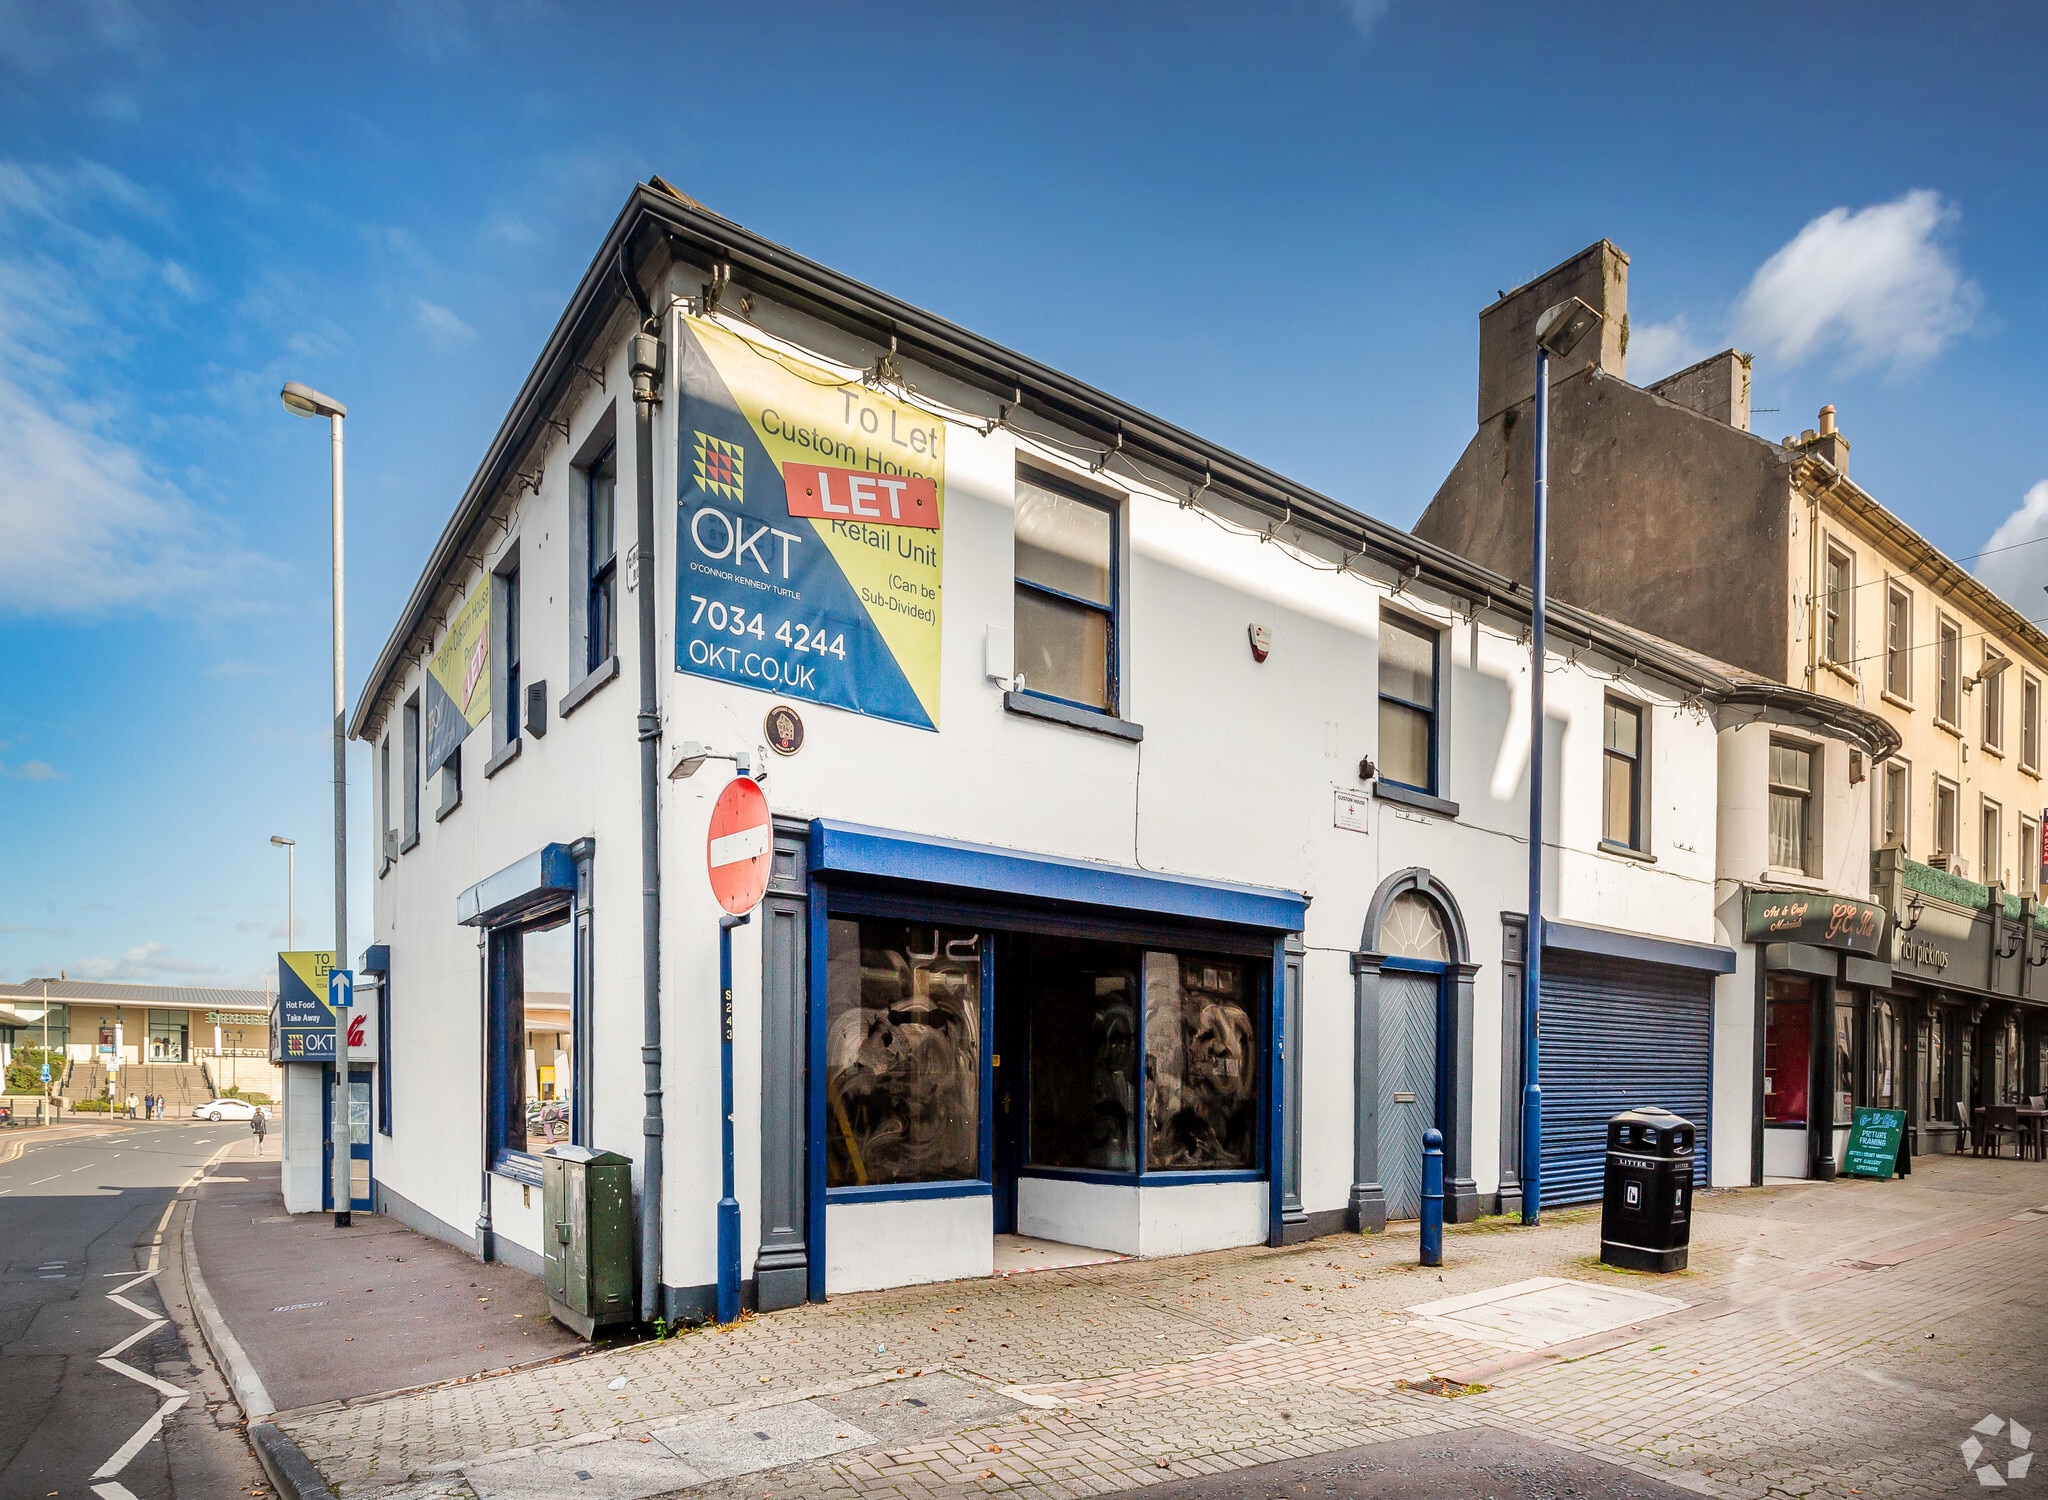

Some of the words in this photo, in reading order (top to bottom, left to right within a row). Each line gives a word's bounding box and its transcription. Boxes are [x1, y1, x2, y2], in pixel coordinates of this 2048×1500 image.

[761, 408, 856, 465] Custom
[837, 387, 879, 434] To
[891, 409, 938, 460] Let
[818, 471, 907, 519] LET
[691, 507, 802, 579] OKT
[832, 519, 890, 552] Retail
[898, 535, 937, 568] Unit
[690, 562, 734, 582] O'CONNOR
[734, 575, 772, 592] KENNEDY
[772, 585, 801, 600] TURTLE
[889, 573, 917, 595] (Can
[921, 584, 936, 600] be
[861, 587, 936, 626] Sub-Divided)
[690, 595, 765, 641] 7034
[774, 620, 846, 661] 4244
[467, 637, 482, 697] LET
[689, 639, 816, 690] OKT.CO.UK
[315, 953, 330, 965] TO
[285, 1001, 298, 1009] Hot
[298, 1001, 316, 1009] Food
[286, 1014, 302, 1022] Take
[303, 1014, 320, 1024] Away
[305, 1034, 337, 1050] OKT
[1859, 1137, 1887, 1147] FRAMING
[1861, 1130, 1887, 1139] PICTURE
[1620, 1159, 1647, 1168] LITTER
